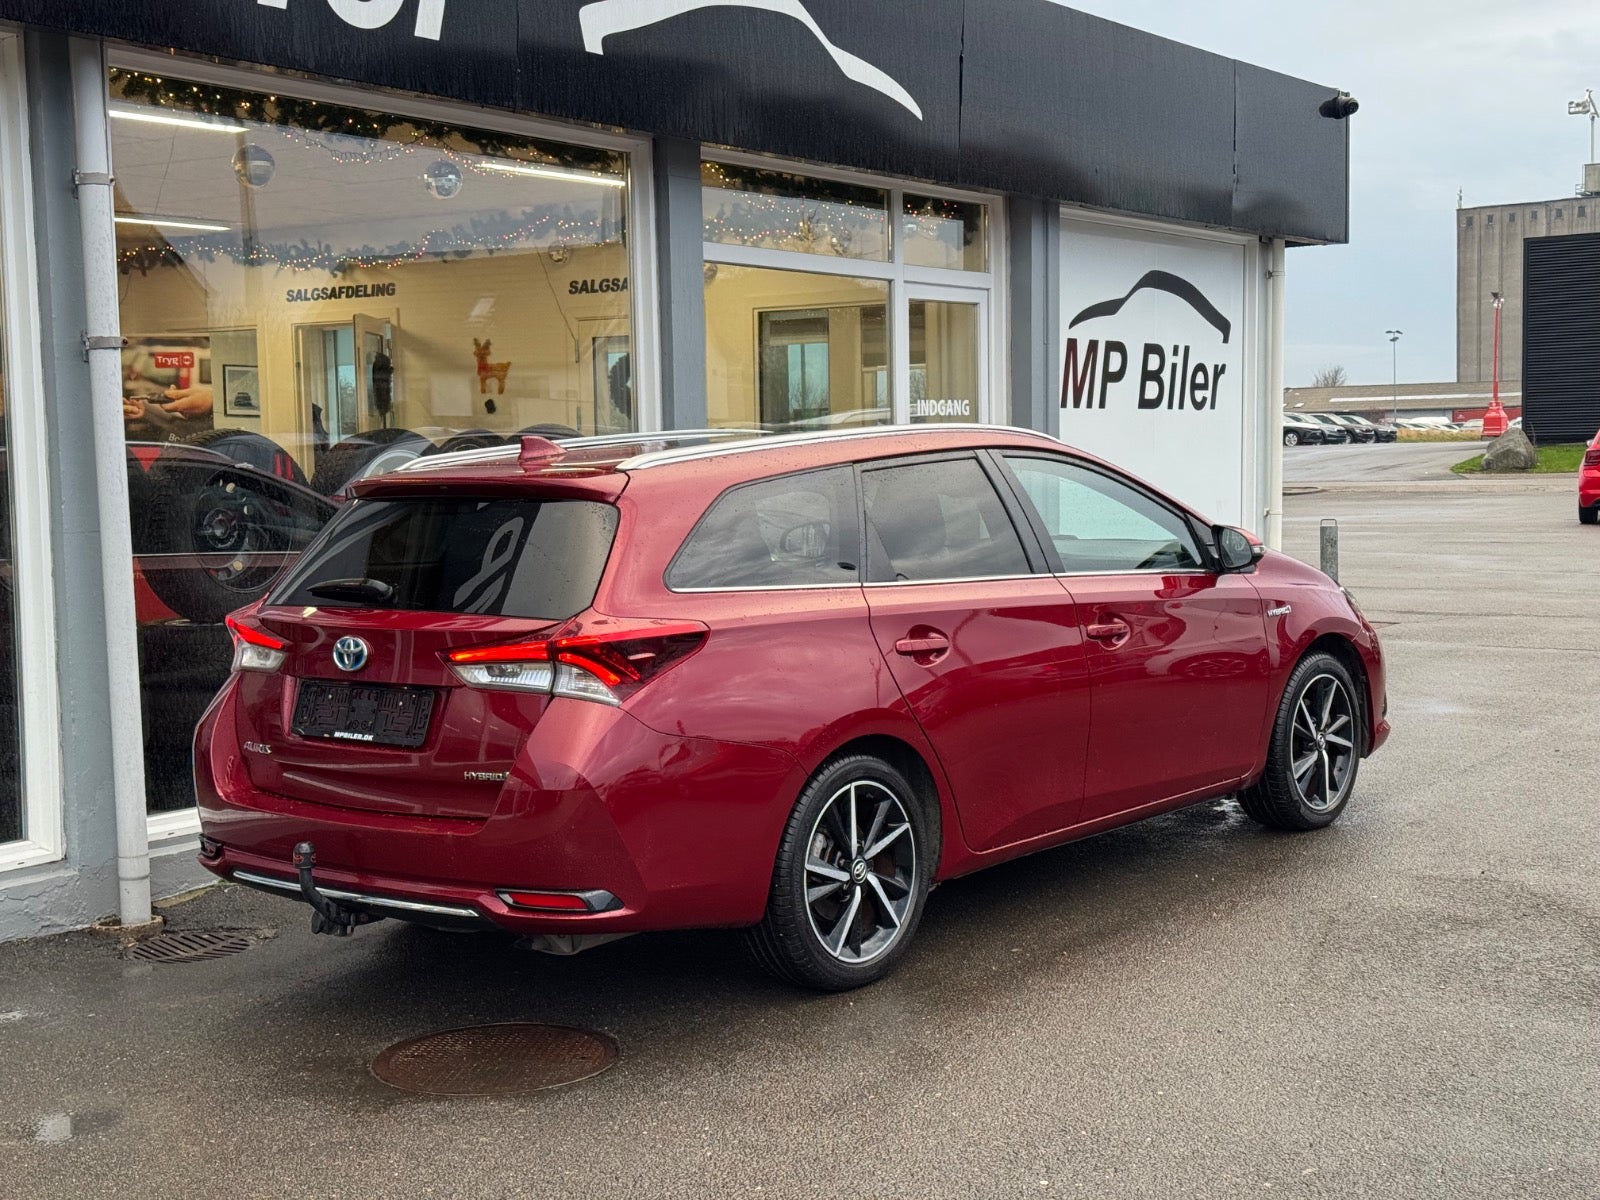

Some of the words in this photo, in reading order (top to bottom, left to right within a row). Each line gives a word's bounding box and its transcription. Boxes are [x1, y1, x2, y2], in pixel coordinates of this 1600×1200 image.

[286, 282, 396, 302] SALGSAFDELING
[156, 356, 178, 365] Tryg
[1060, 338, 1128, 409] MP
[1138, 343, 1227, 411] Biler
[917, 399, 970, 416] INDGANG
[464, 771, 505, 781] HYBRID
